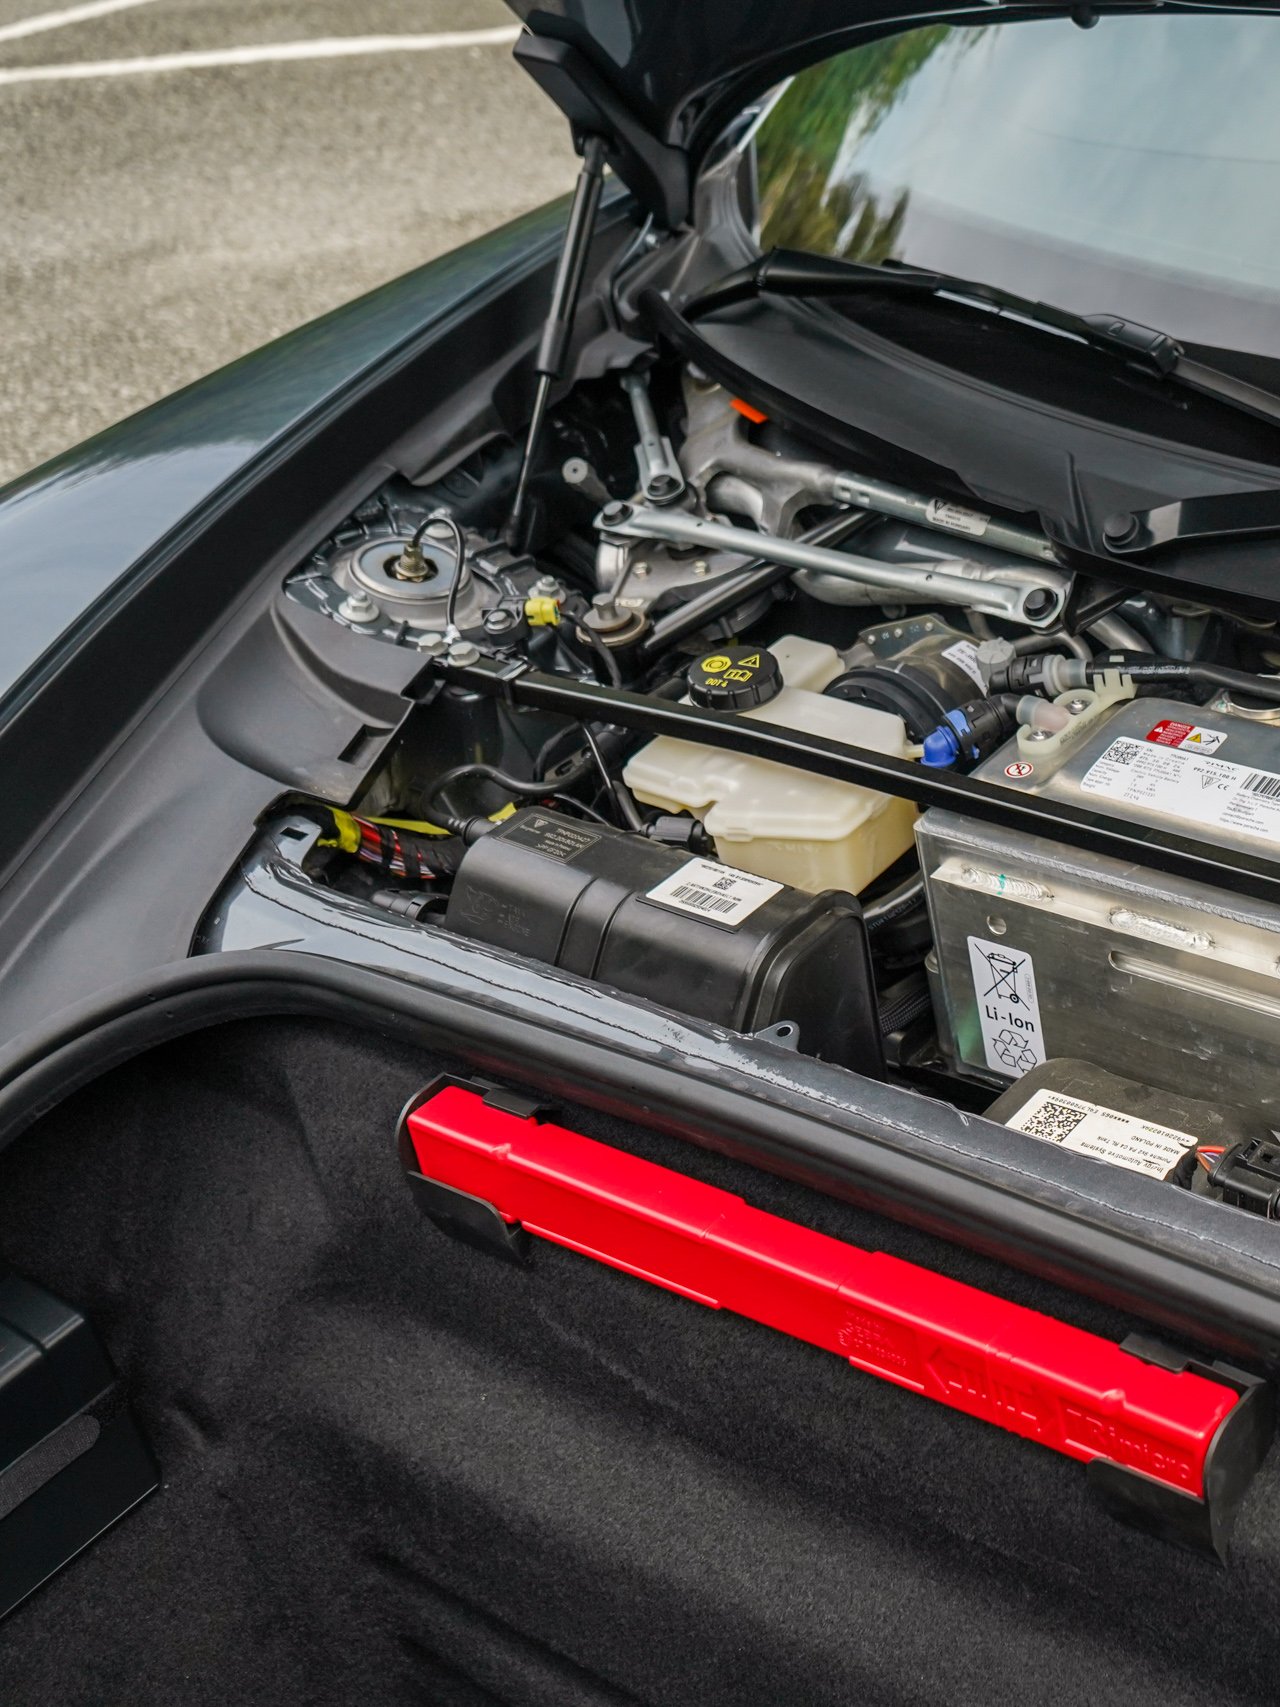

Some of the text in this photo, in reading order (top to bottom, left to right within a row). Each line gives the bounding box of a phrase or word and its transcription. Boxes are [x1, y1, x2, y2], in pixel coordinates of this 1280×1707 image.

[704, 677, 722, 687] DOT
[985, 1005, 1035, 1033] Li-Ion
[1130, 1135, 1154, 1145] POLAND
[1079, 1141, 1107, 1153] Systems
[1161, 1146, 1180, 1154] MADE
[1106, 1150, 1142, 1165] Automotive
[1148, 1153, 1172, 1163] Porsche
